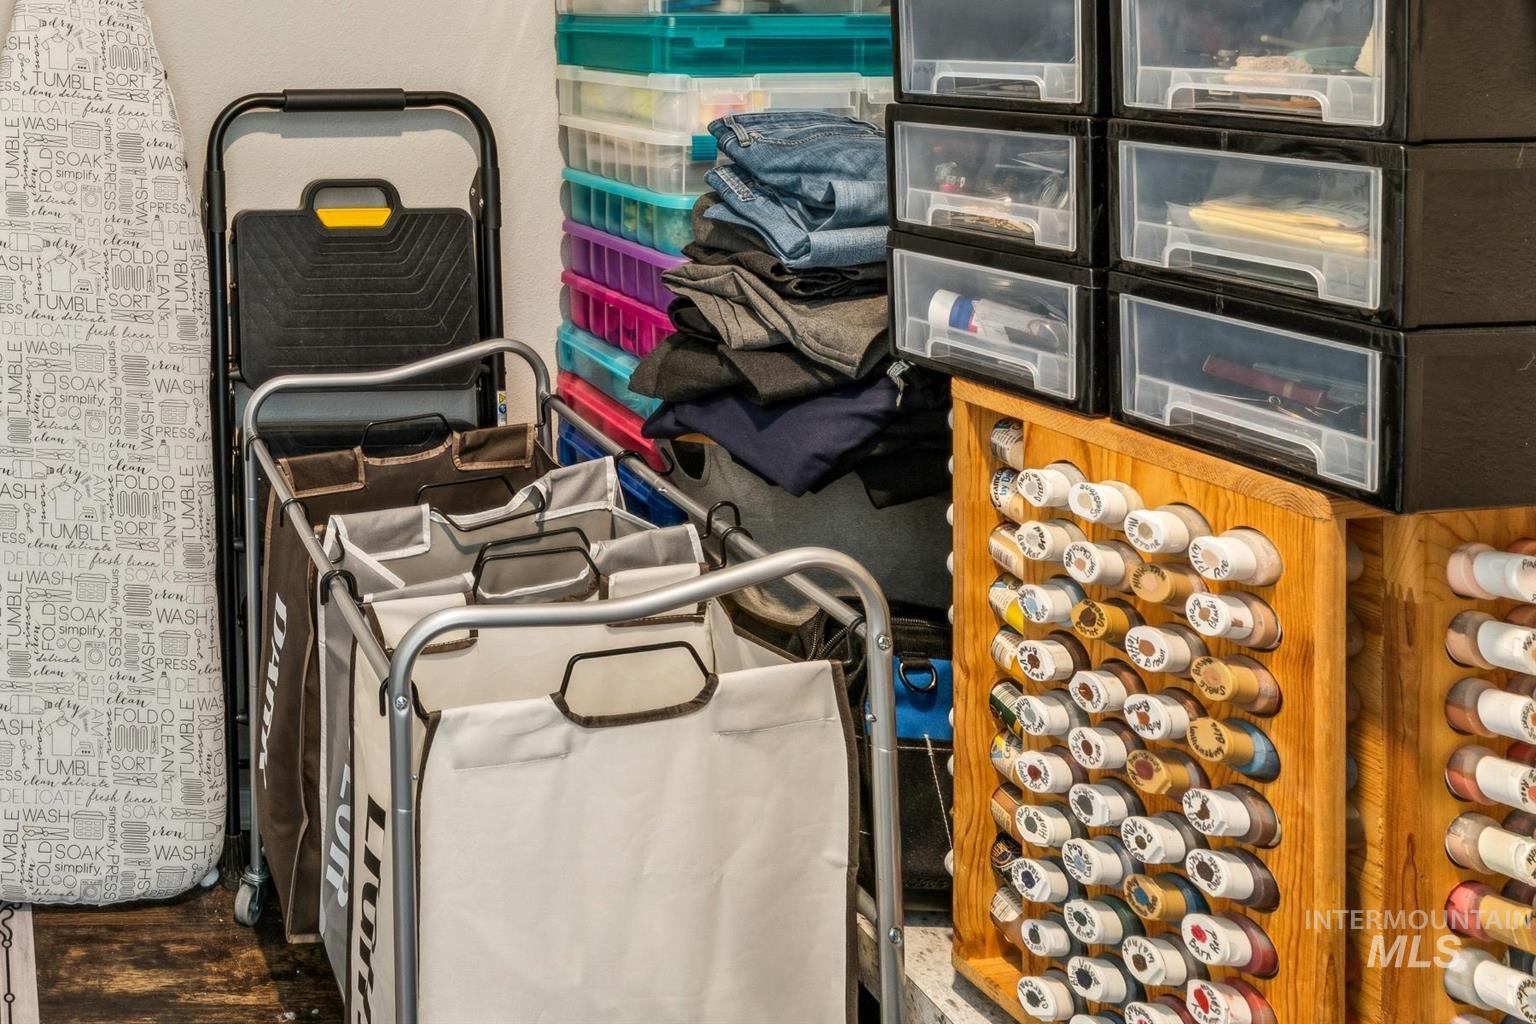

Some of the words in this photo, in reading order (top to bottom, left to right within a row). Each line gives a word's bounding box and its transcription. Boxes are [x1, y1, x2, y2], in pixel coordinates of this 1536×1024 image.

[48, 17, 74, 36] dry
[99, 16, 135, 32] clean
[107, 30, 147, 46] FOLD
[32, 71, 103, 91] TUMBLE
[22, 86, 55, 98] clean
[59, 88, 104, 101] delicate
[82, 102, 113, 118] fresh
[117, 105, 150, 117] linen
[39, 148, 53, 193] FOLD
[55, 169, 100, 183] simplify.
[135, 177, 148, 225] WASH
[31, 208, 64, 218] clean
[105, 215, 136, 225] iron
[110, 249, 153, 264] FOLD
[173, 240, 188, 313] TUMBLE
[109, 294, 151, 309] SORT
[24, 309, 57, 321] clean
[61, 312, 108, 323] delicate
[85, 325, 117, 341] fresh
[121, 327, 154, 339] linen
[154, 378, 204, 394] WASH
[42, 373, 57, 418] FOLD
[141, 401, 154, 451] WASH
[107, 459, 151, 475] clean
[116, 475, 159, 491] FOLD
[114, 521, 157, 535] SORT
[3, 551, 87, 568] DELICATE
[89, 553, 123, 569] fresh
[126, 555, 160, 567] linen
[154, 588, 187, 602] iron
[7, 570, 23, 649] TUMBLE
[156, 608, 208, 626] WASH
[54, 697, 81, 718] dry
[34, 758, 108, 777] TUMBLE
[0, 788, 83, 806] DELICATE
[85, 790, 120, 808] fresh
[123, 792, 158, 804] linen
[23, 809, 70, 823] WASH
[122, 806, 168, 820] SOAK
[152, 827, 186, 840] iron
[54, 844, 105, 862] SOAK
[154, 845, 206, 862] WASH
[37, 841, 52, 887] FOLD
[54, 862, 102, 876] simplify.
[103, 855, 119, 900] PRESS
